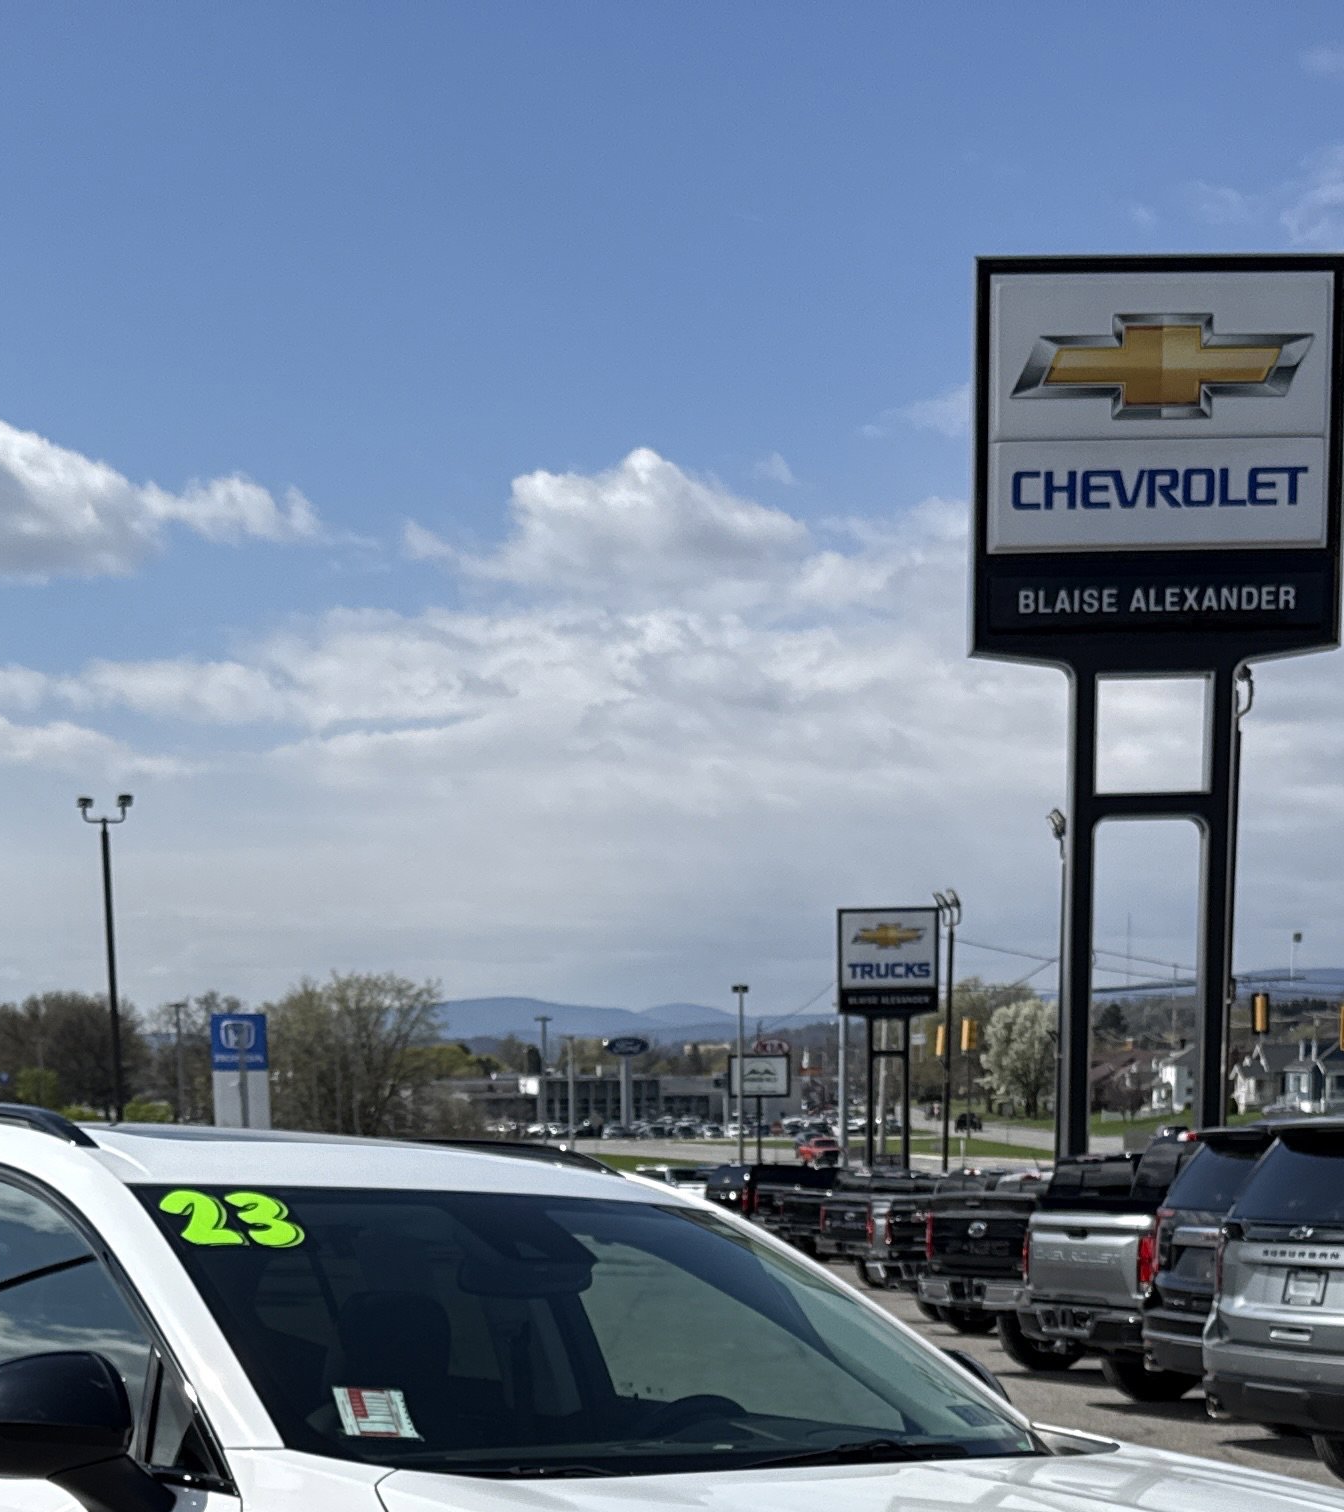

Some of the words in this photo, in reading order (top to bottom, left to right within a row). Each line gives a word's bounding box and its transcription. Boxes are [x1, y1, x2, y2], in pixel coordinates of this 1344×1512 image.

[1011, 466, 1308, 511] CHEVROLET
[1018, 587, 1118, 614] BLAISE
[1129, 585, 1296, 613] ALEXANDER
[847, 962, 931, 979] TRUCKS
[159, 1189, 305, 1248] 23
[1262, 1249, 1340, 1260] SUBURBAN
